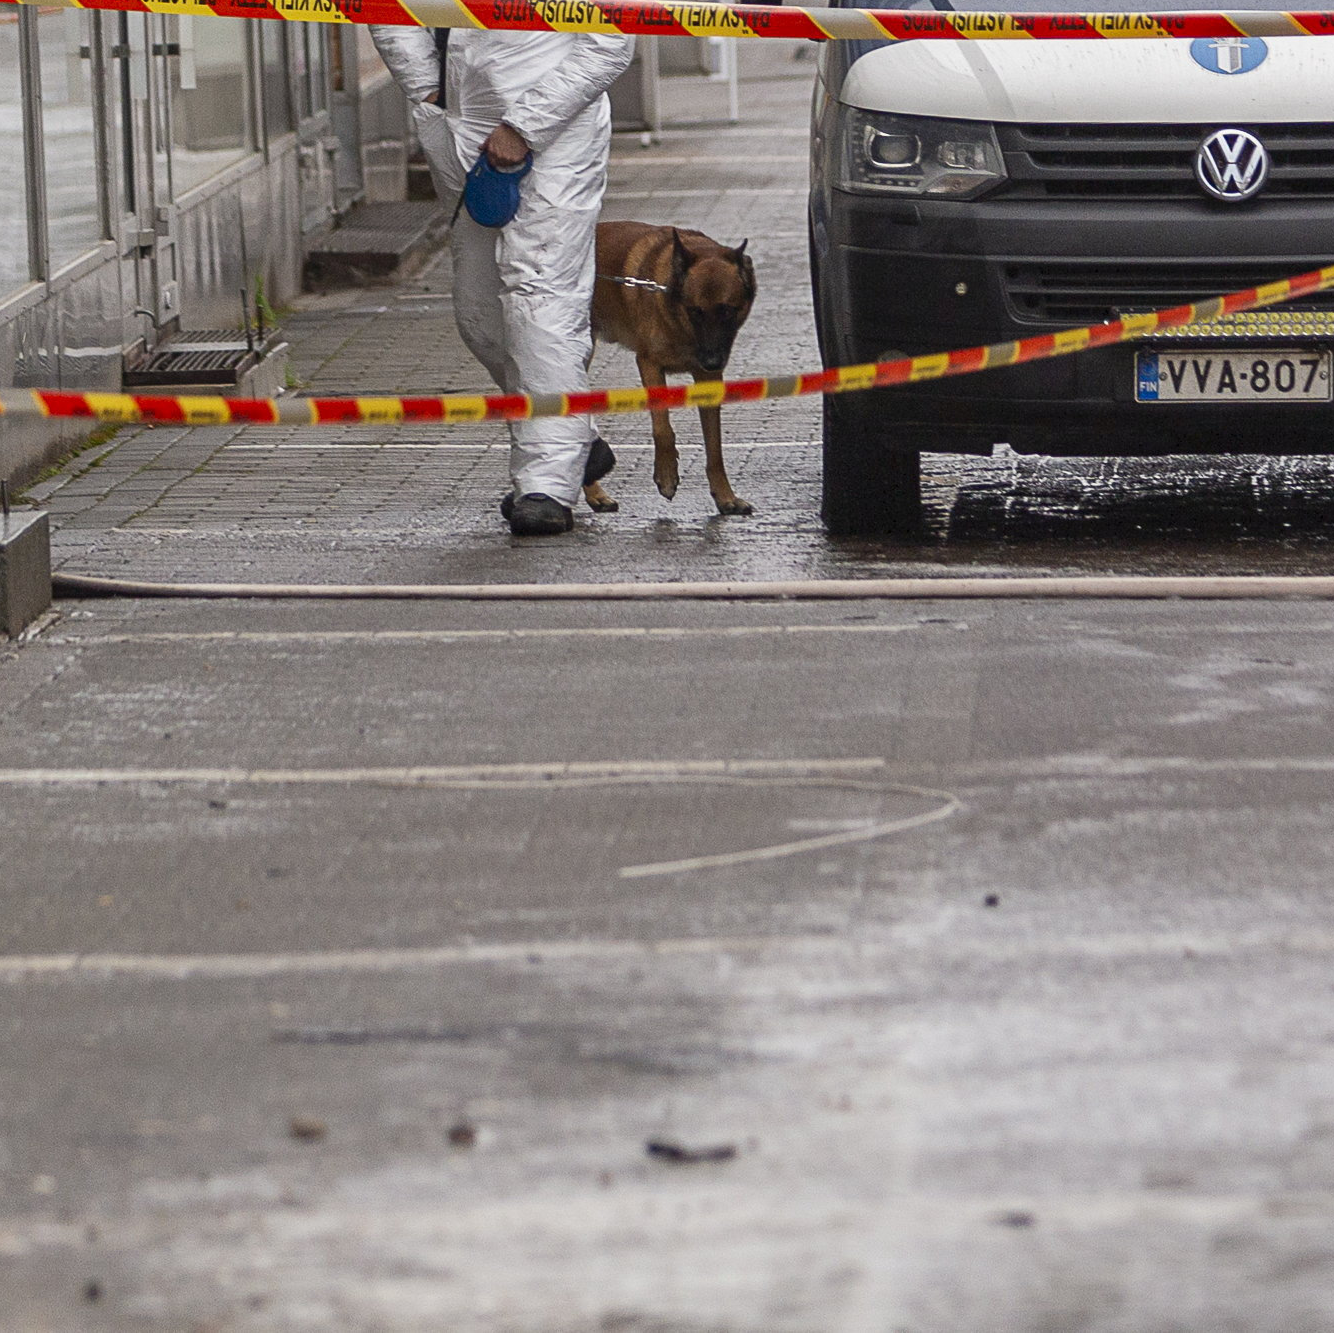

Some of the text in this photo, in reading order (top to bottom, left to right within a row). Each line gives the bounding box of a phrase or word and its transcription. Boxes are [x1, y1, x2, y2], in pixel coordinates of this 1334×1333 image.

[636, 5, 718, 27] KIELLETTY
[1139, 381, 1157, 392] FIN
[1166, 359, 1321, 394] VVA-807
